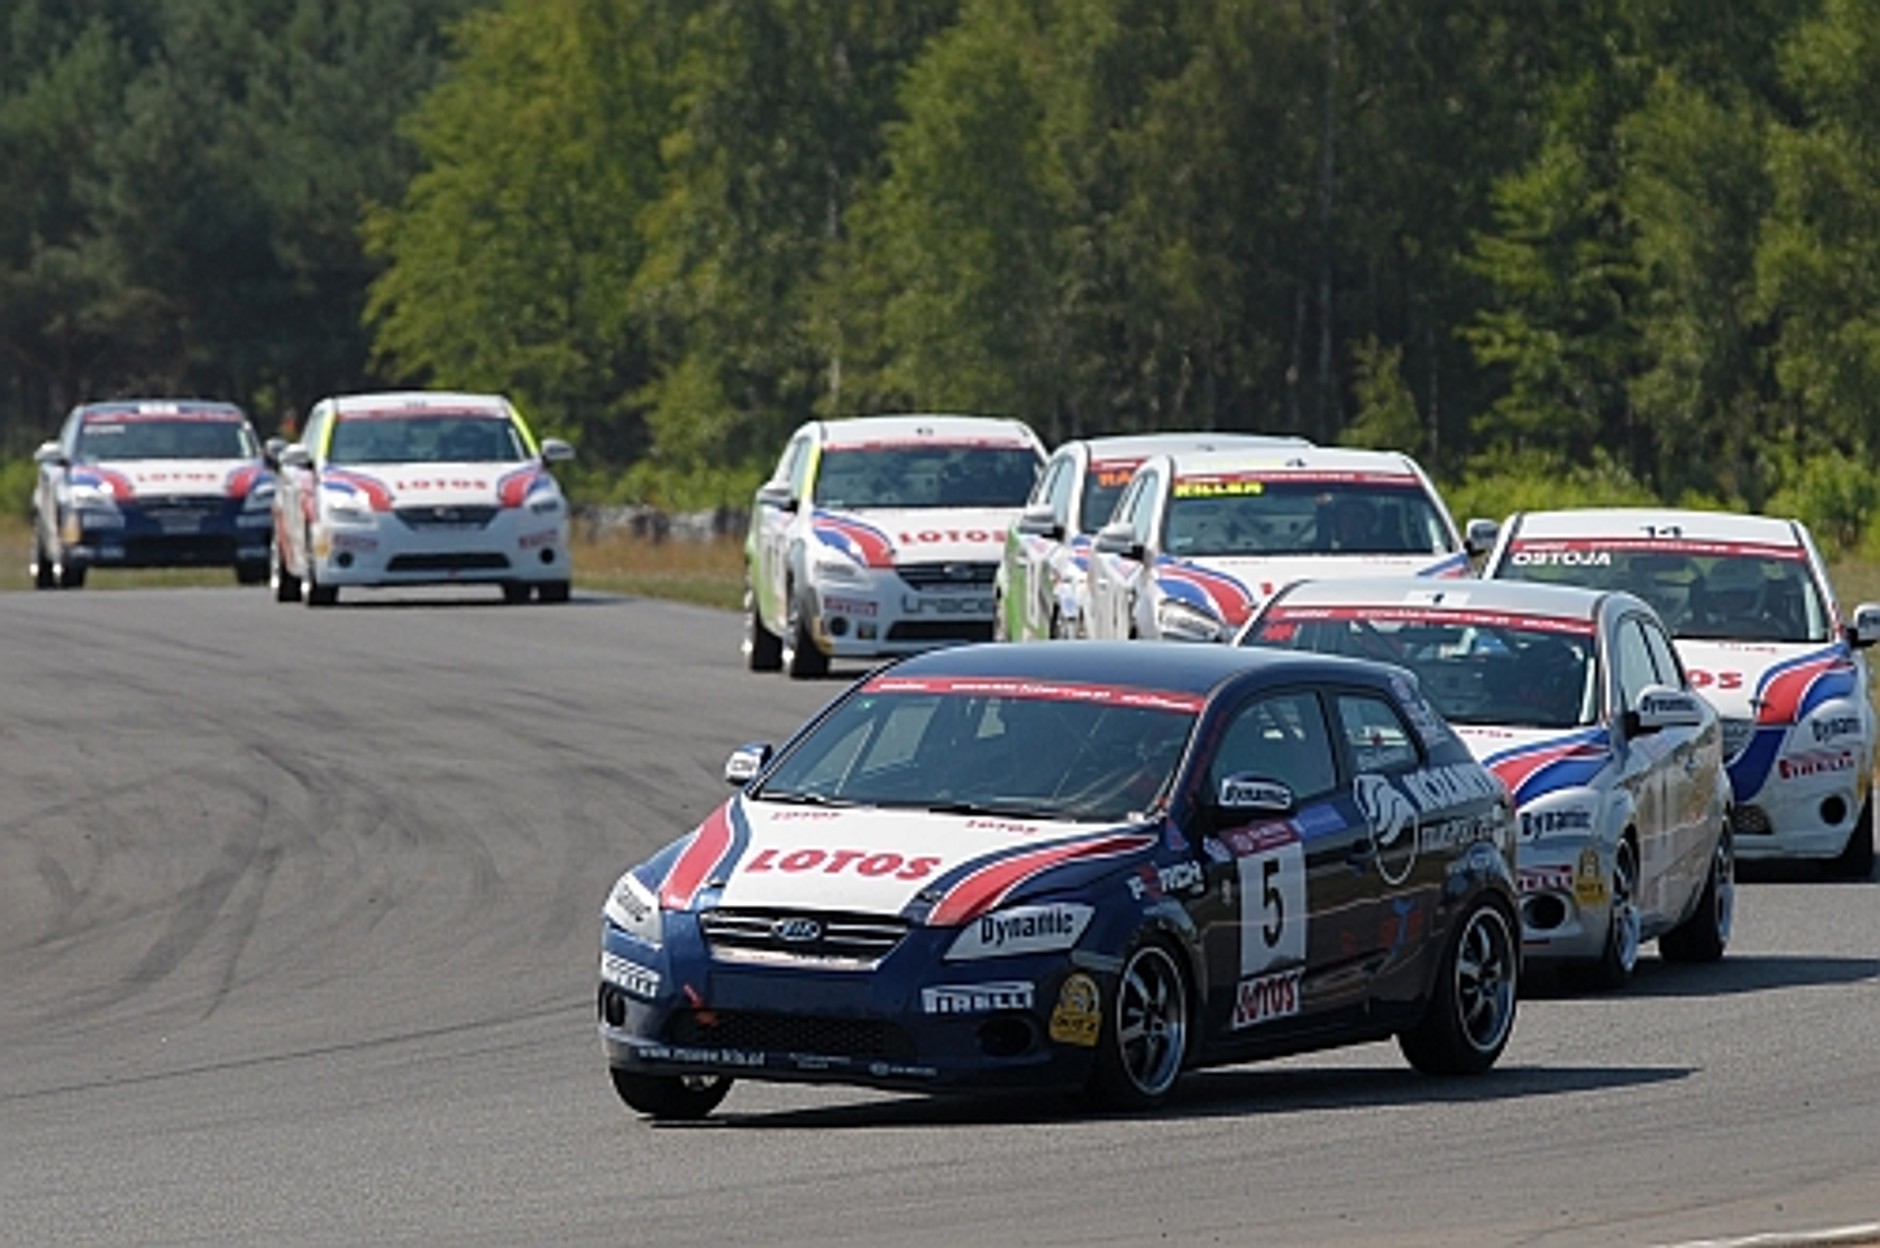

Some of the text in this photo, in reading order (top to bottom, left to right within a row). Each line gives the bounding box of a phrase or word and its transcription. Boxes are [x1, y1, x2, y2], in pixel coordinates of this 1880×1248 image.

[395, 480, 488, 491] LOTOS
[1640, 525, 1683, 539] 14
[1511, 551, 1612, 566] OSTOJA
[1522, 811, 1592, 841] Dynamic
[744, 850, 942, 882] LOTOS
[1263, 858, 1284, 949] 5
[979, 909, 1074, 947] Dynamic
[920, 980, 1036, 1014] PIRELLI
[1235, 973, 1297, 1025] LOTOS
